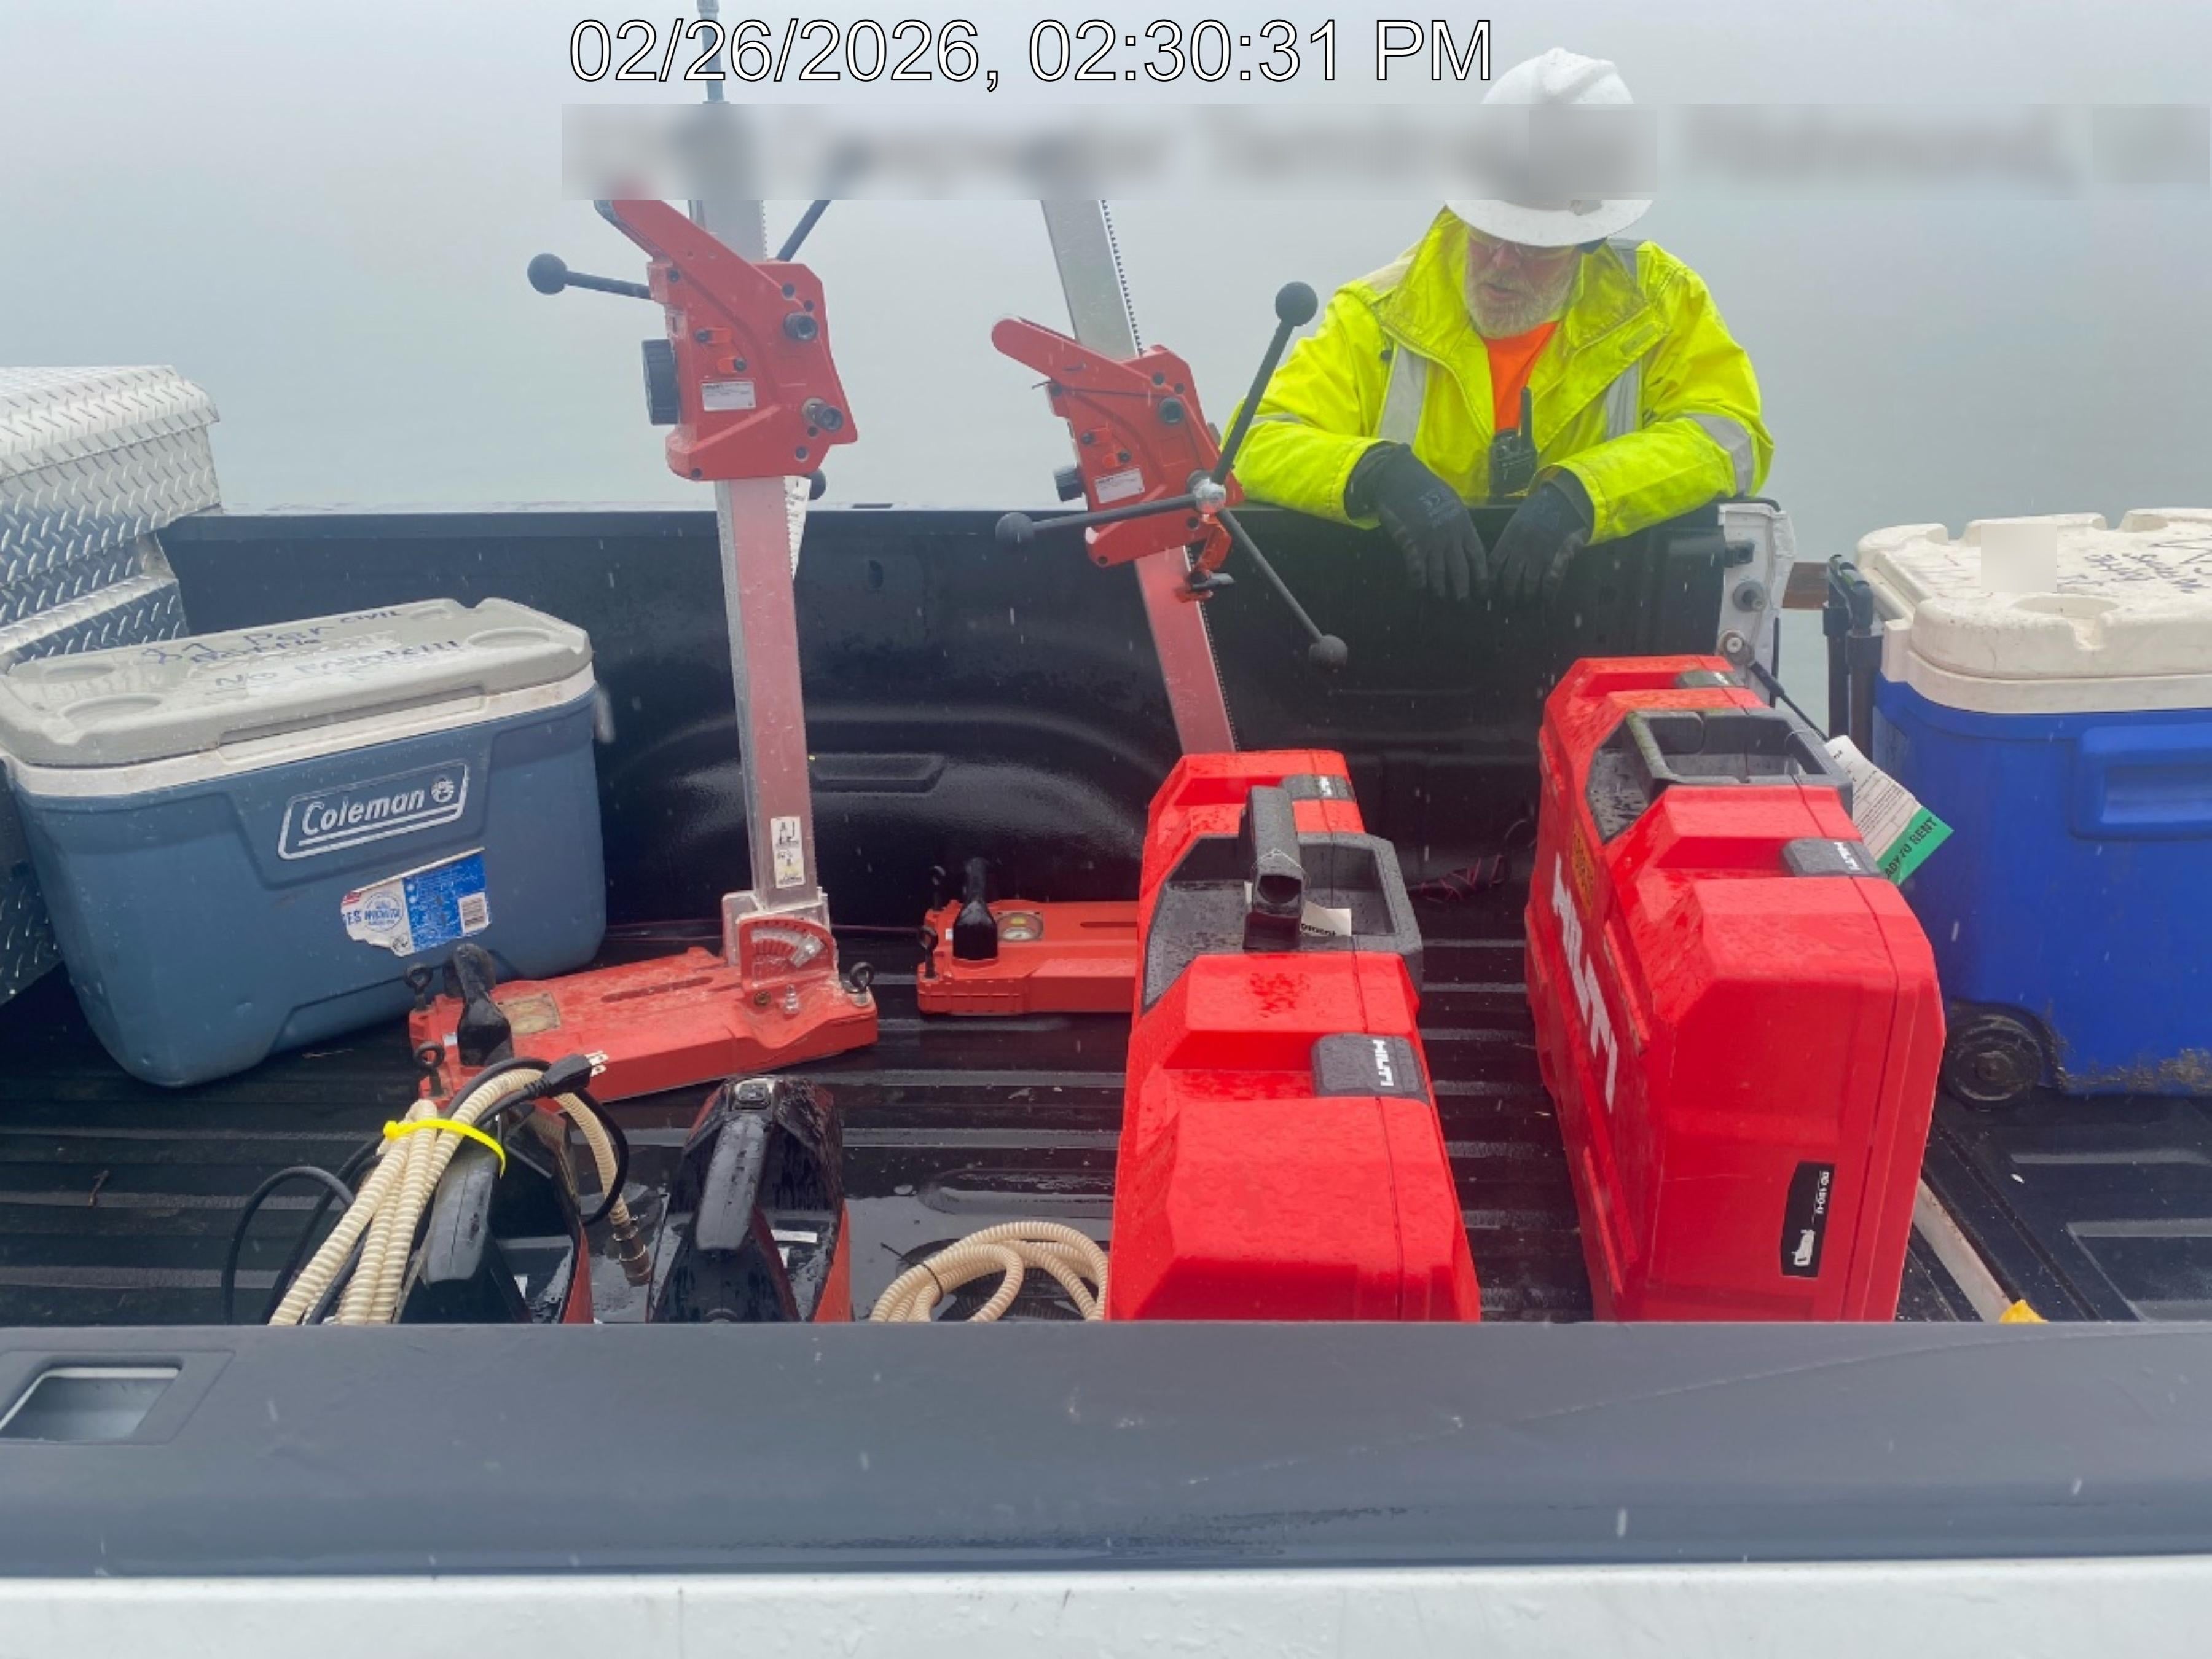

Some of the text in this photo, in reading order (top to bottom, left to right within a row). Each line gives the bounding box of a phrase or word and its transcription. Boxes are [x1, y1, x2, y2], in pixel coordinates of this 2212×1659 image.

[302, 790, 425, 836] Coleman
[1884, 857, 1901, 879] ADY
[1909, 816, 1938, 845] RENT
[1371, 1039, 1394, 1087] HILTI
